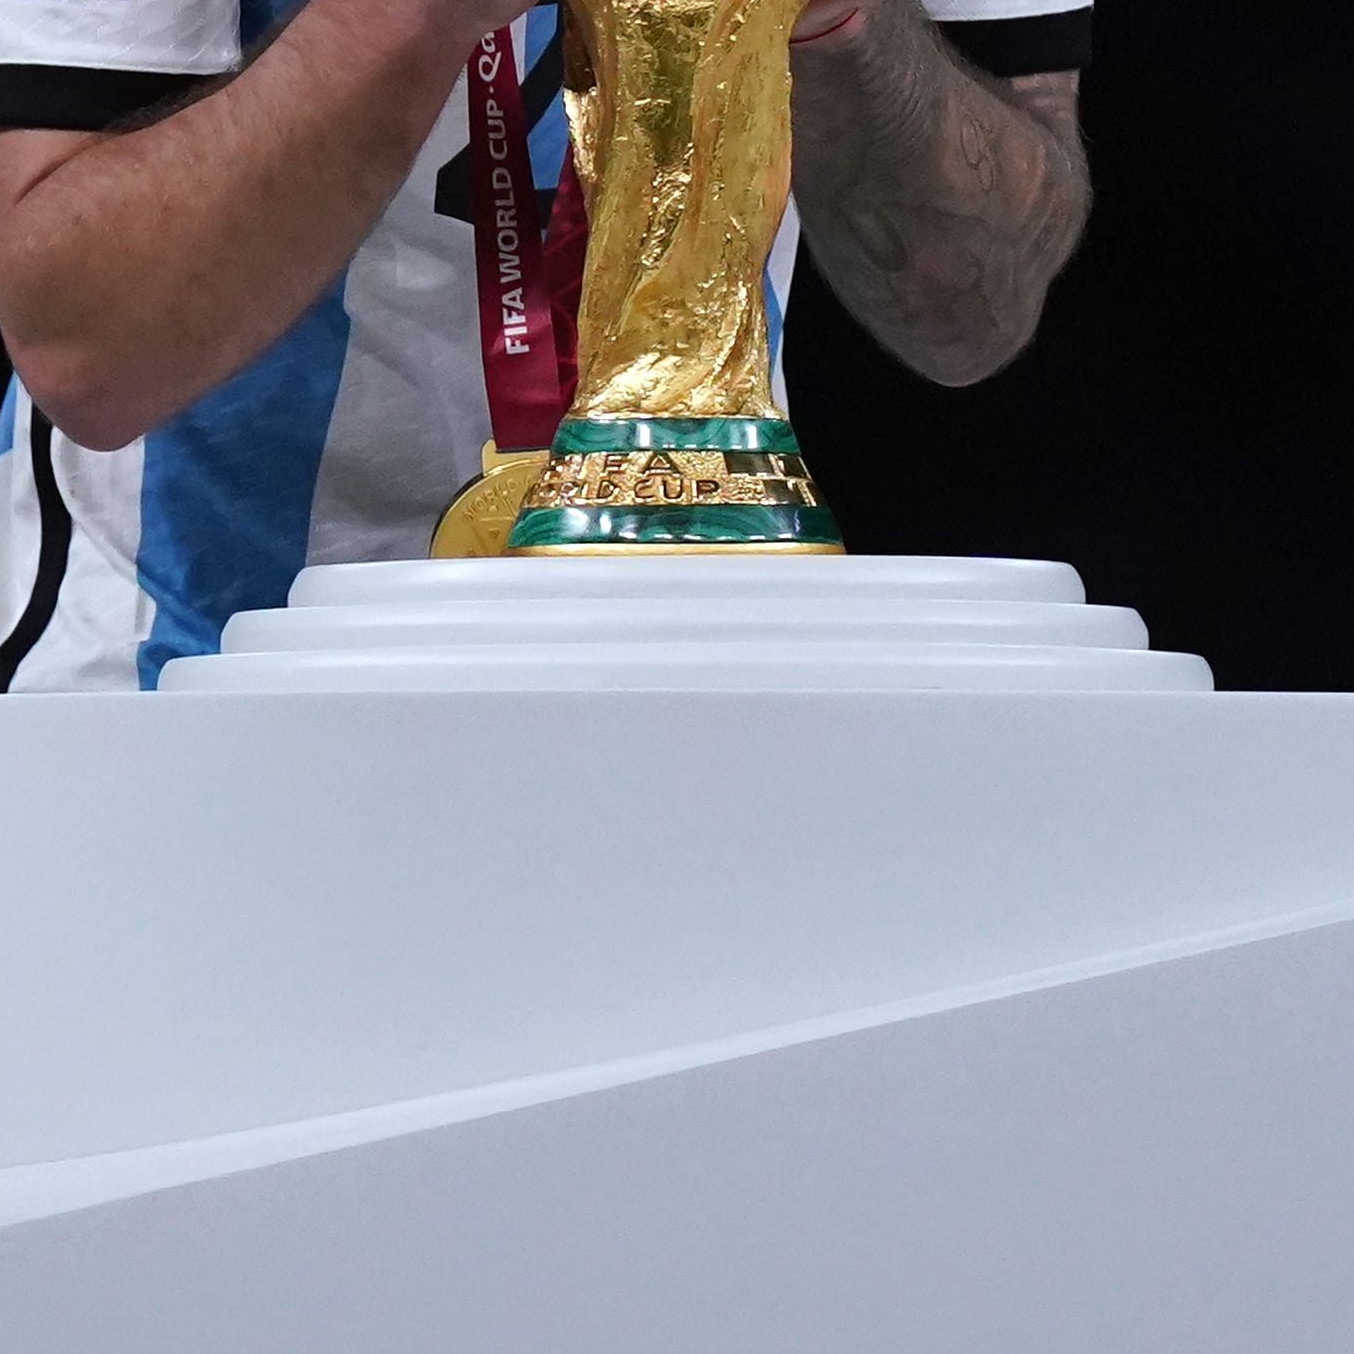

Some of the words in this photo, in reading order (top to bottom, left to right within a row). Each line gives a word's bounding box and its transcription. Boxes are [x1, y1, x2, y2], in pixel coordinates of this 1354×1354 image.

[485, 99, 508, 161] CUP
[492, 167, 522, 284] WORLD
[501, 287, 530, 355] FIFA
[633, 477, 722, 504] CUP
